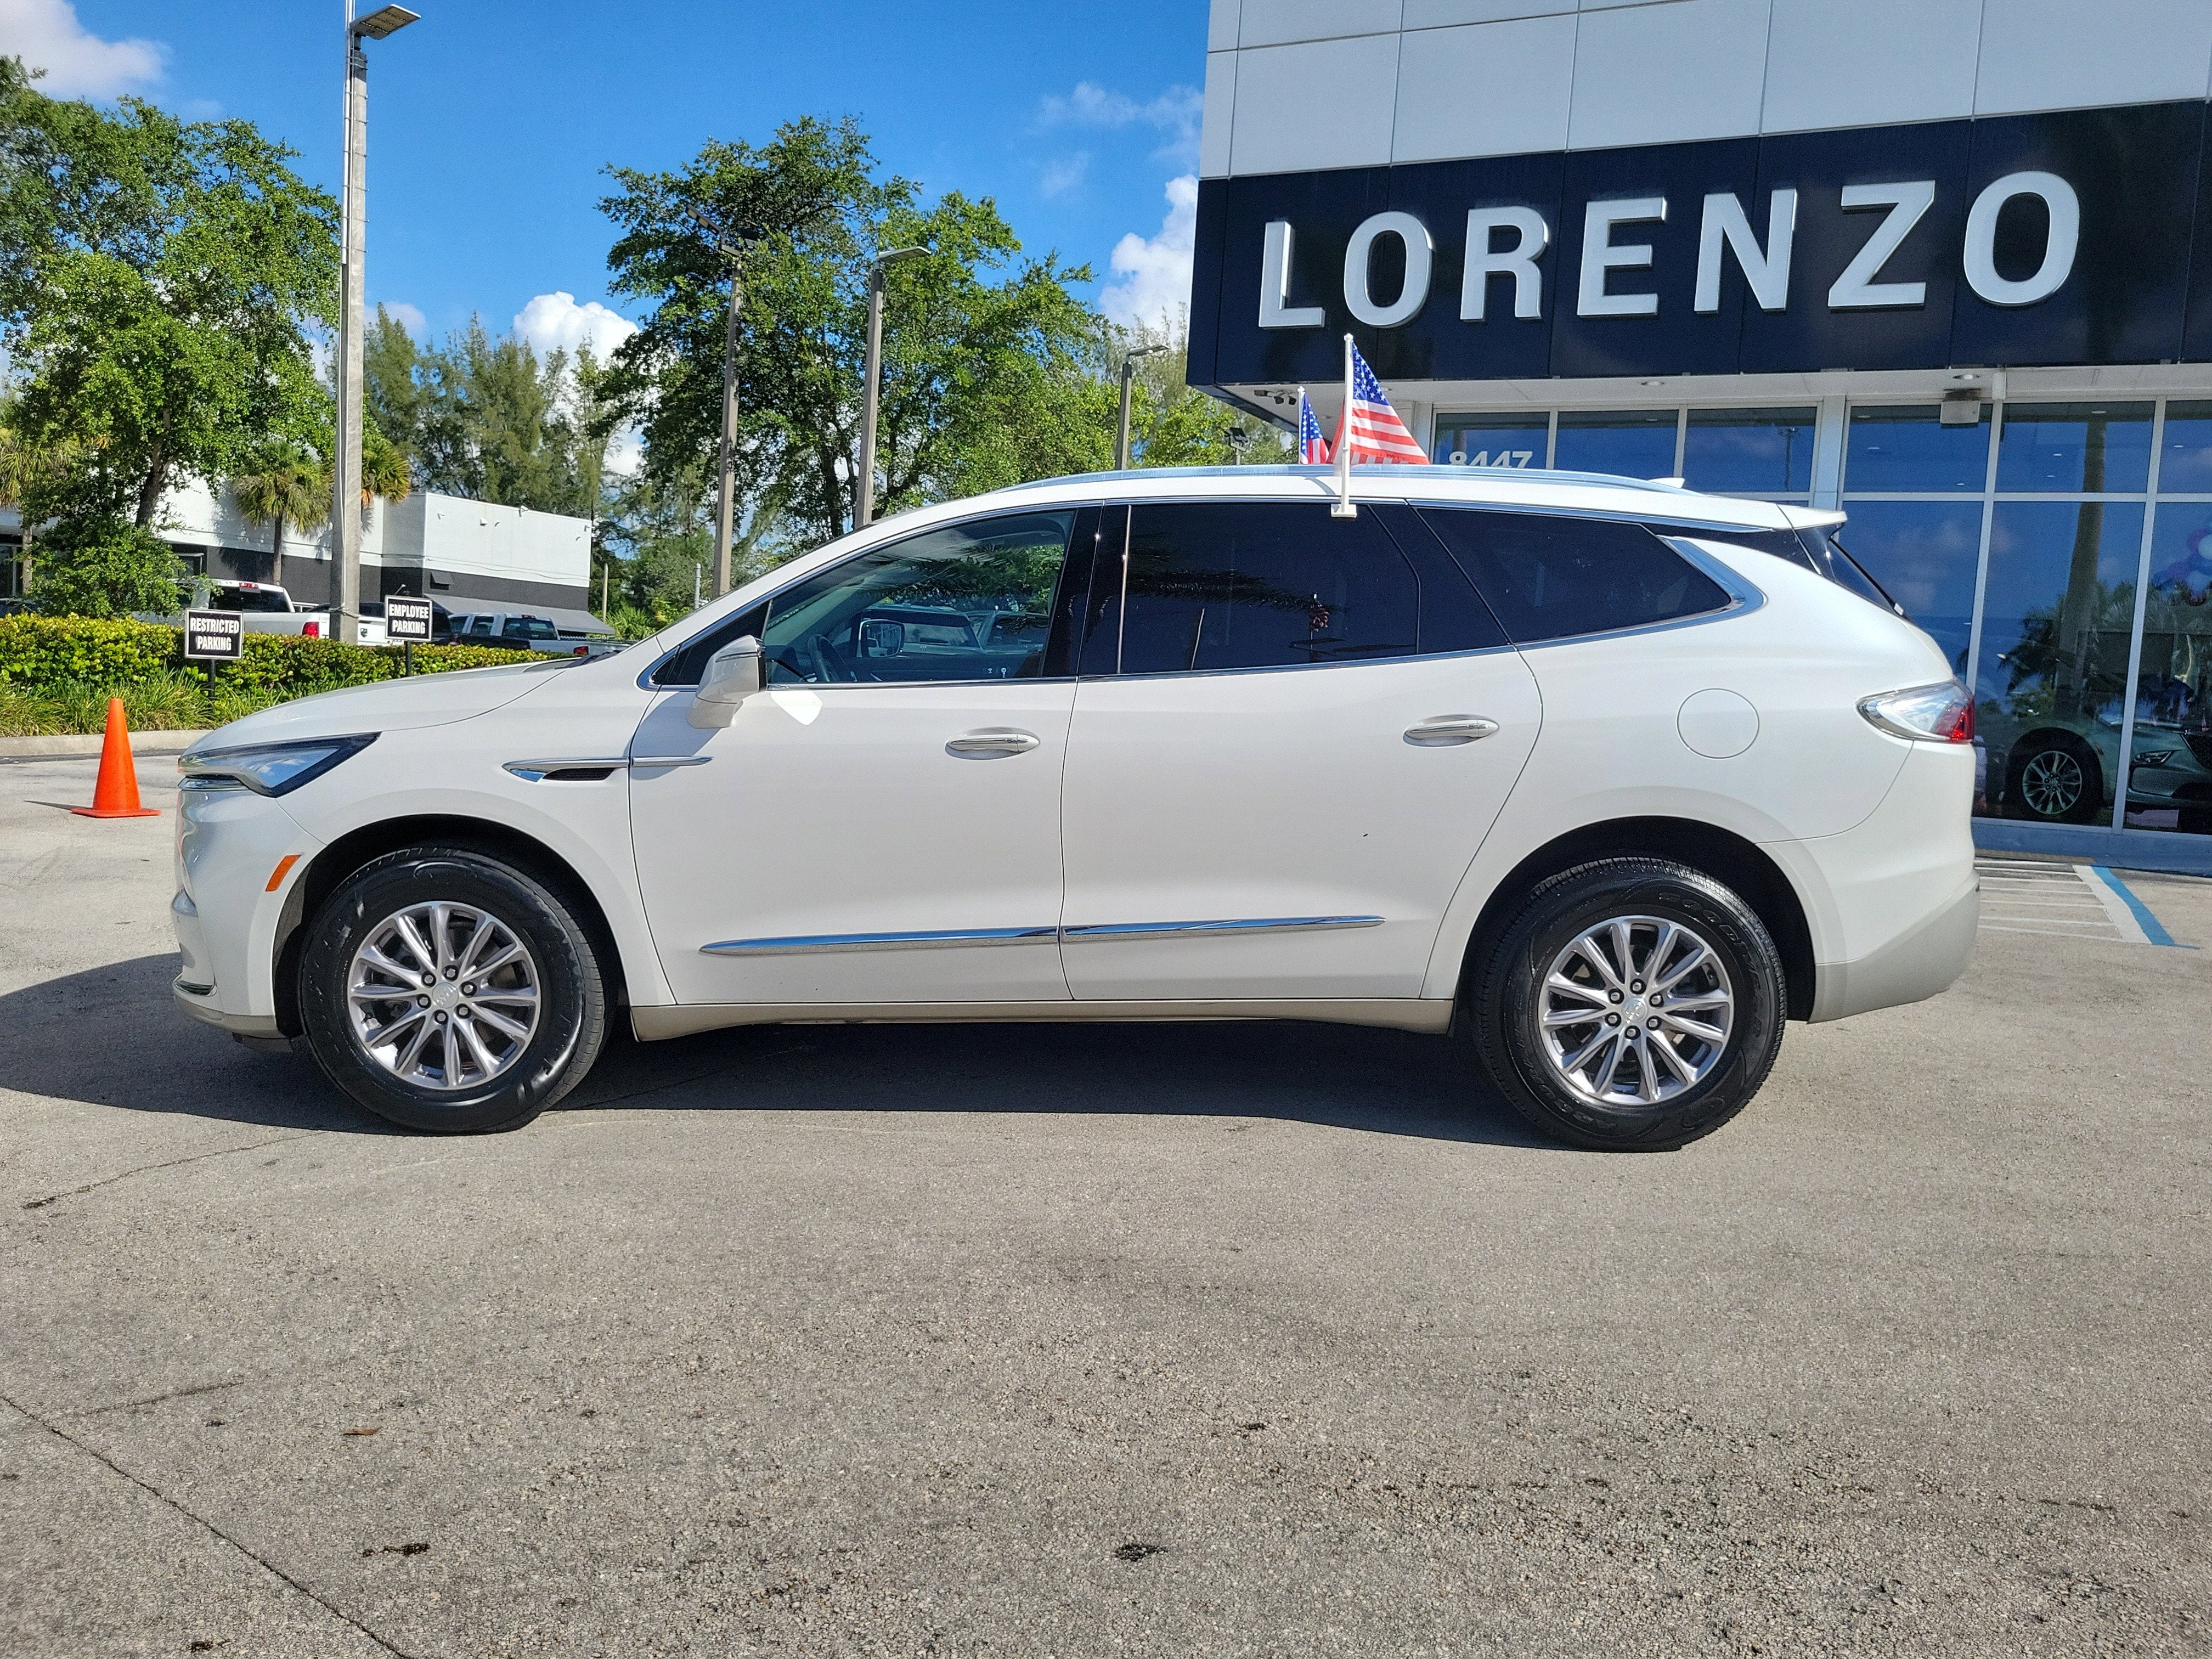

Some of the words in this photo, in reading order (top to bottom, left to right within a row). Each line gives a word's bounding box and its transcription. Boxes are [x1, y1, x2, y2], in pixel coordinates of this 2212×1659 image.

[1258, 171, 2080, 328] LORENZO
[389, 604, 428, 618] EMPLOYEE
[190, 617, 239, 633] RESTRICTED
[392, 619, 425, 634] PARKING
[196, 636, 232, 651] PARKING
